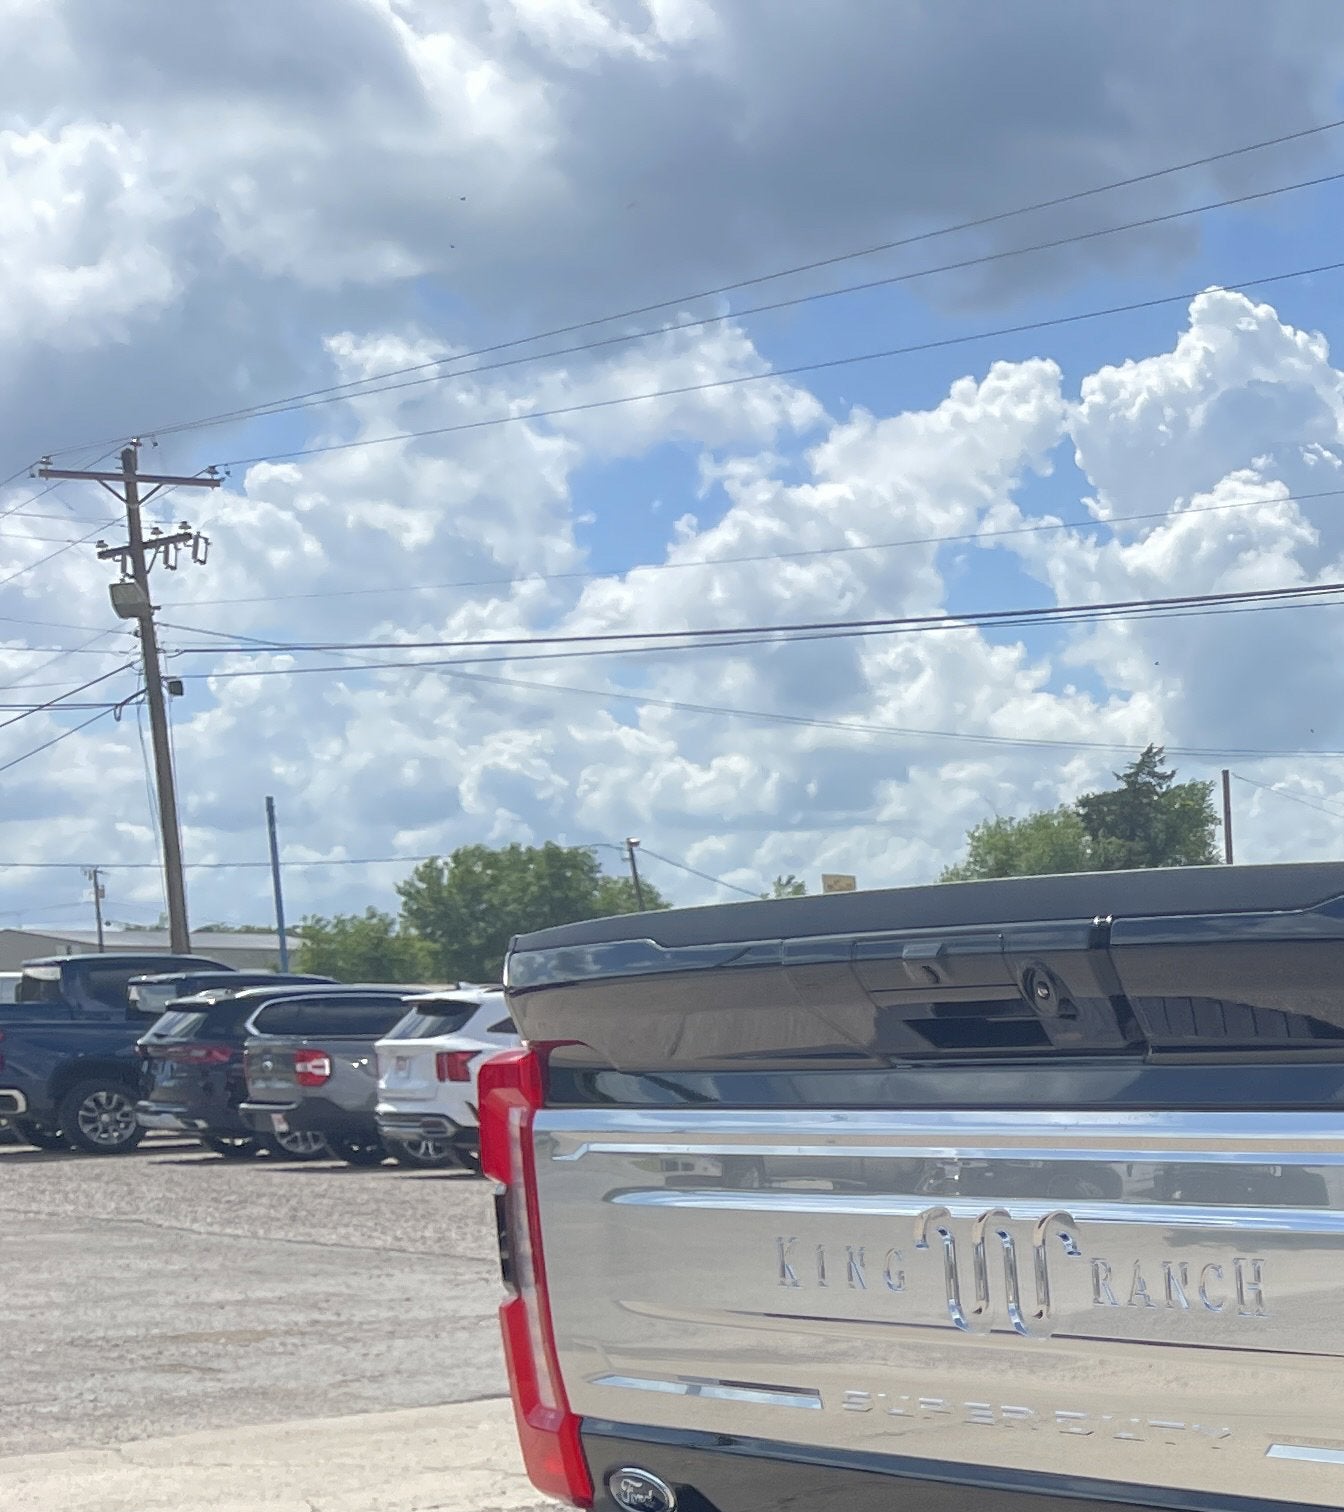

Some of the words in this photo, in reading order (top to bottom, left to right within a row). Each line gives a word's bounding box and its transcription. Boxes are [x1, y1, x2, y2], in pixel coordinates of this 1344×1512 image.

[776, 1235, 908, 1294] KING
[1088, 1256, 1271, 1318] RANCH
[841, 1389, 1040, 1432] SUPER
[1053, 1409, 1233, 1450] DUTY
[620, 1478, 656, 1509] Ford
